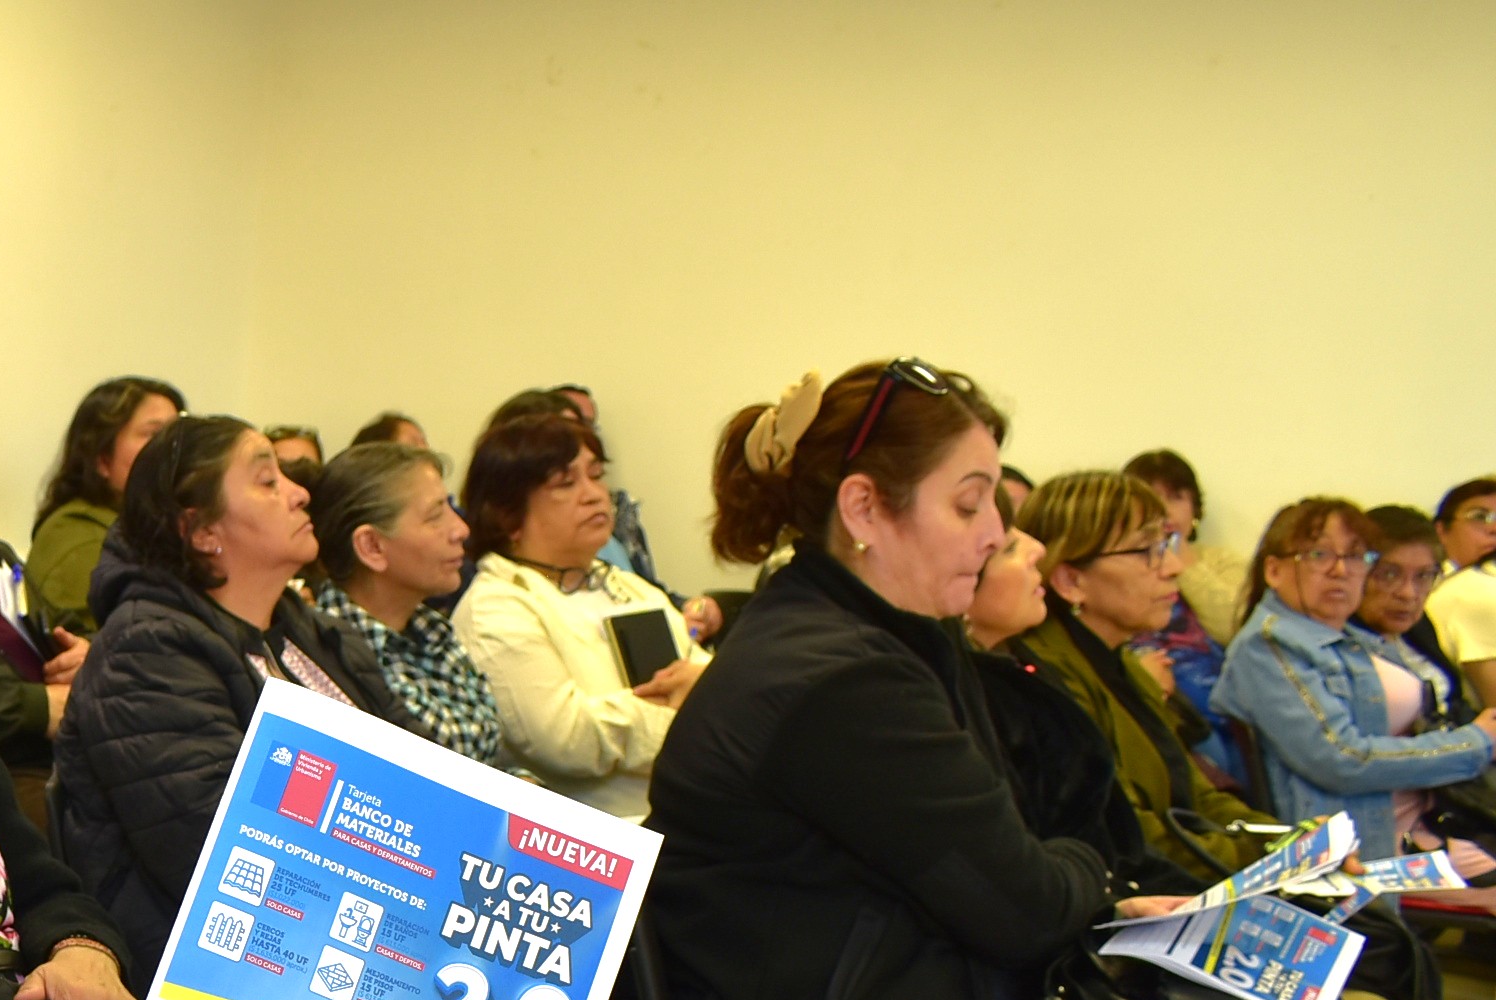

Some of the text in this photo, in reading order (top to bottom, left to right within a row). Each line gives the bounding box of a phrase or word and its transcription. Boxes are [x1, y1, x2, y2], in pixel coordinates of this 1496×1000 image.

[297, 759, 319, 772] Vivienda
[299, 753, 325, 768] Ministerio
[295, 766, 322, 781] Urbanismo
[345, 783, 383, 808] Tarjeta
[340, 797, 413, 837] BANCO DE
[334, 812, 422, 858] MATERIALES
[332, 829, 433, 877] PARA CASAS Y DEPARTAMENTOS
[517, 824, 618, 879] ¡NUEVA!
[238, 822, 428, 910] PODRÁS OPTAR POR PROYECTOS DE:
[276, 866, 321, 889] REPARACIÓN
[270, 881, 296, 897] 25 UF
[274, 873, 331, 902] DE TECHUMBRES
[458, 853, 595, 928] TU CASA
[266, 899, 301, 919] SOLO CASAS
[492, 898, 549, 933] A TU
[256, 922, 285, 938] CERCOS
[383, 920, 418, 938] DE BAÑOS
[386, 912, 430, 935] REPARACIÓN
[259, 931, 281, 944] REJAS
[380, 928, 406, 943] 15 UF
[441, 903, 573, 984] PINTA
[251, 936, 309, 966] HASTA 40 UF
[375, 946, 394, 958] CASAS
[398, 955, 423, 970] DEPTOS.
[246, 954, 281, 973] SOLO CASAS
[1216, 944, 1264, 990] 2.0
[360, 982, 386, 998] 15 UF
[363, 975, 394, 992] DE PISOS
[365, 967, 421, 995] MEJORAMIENTO
